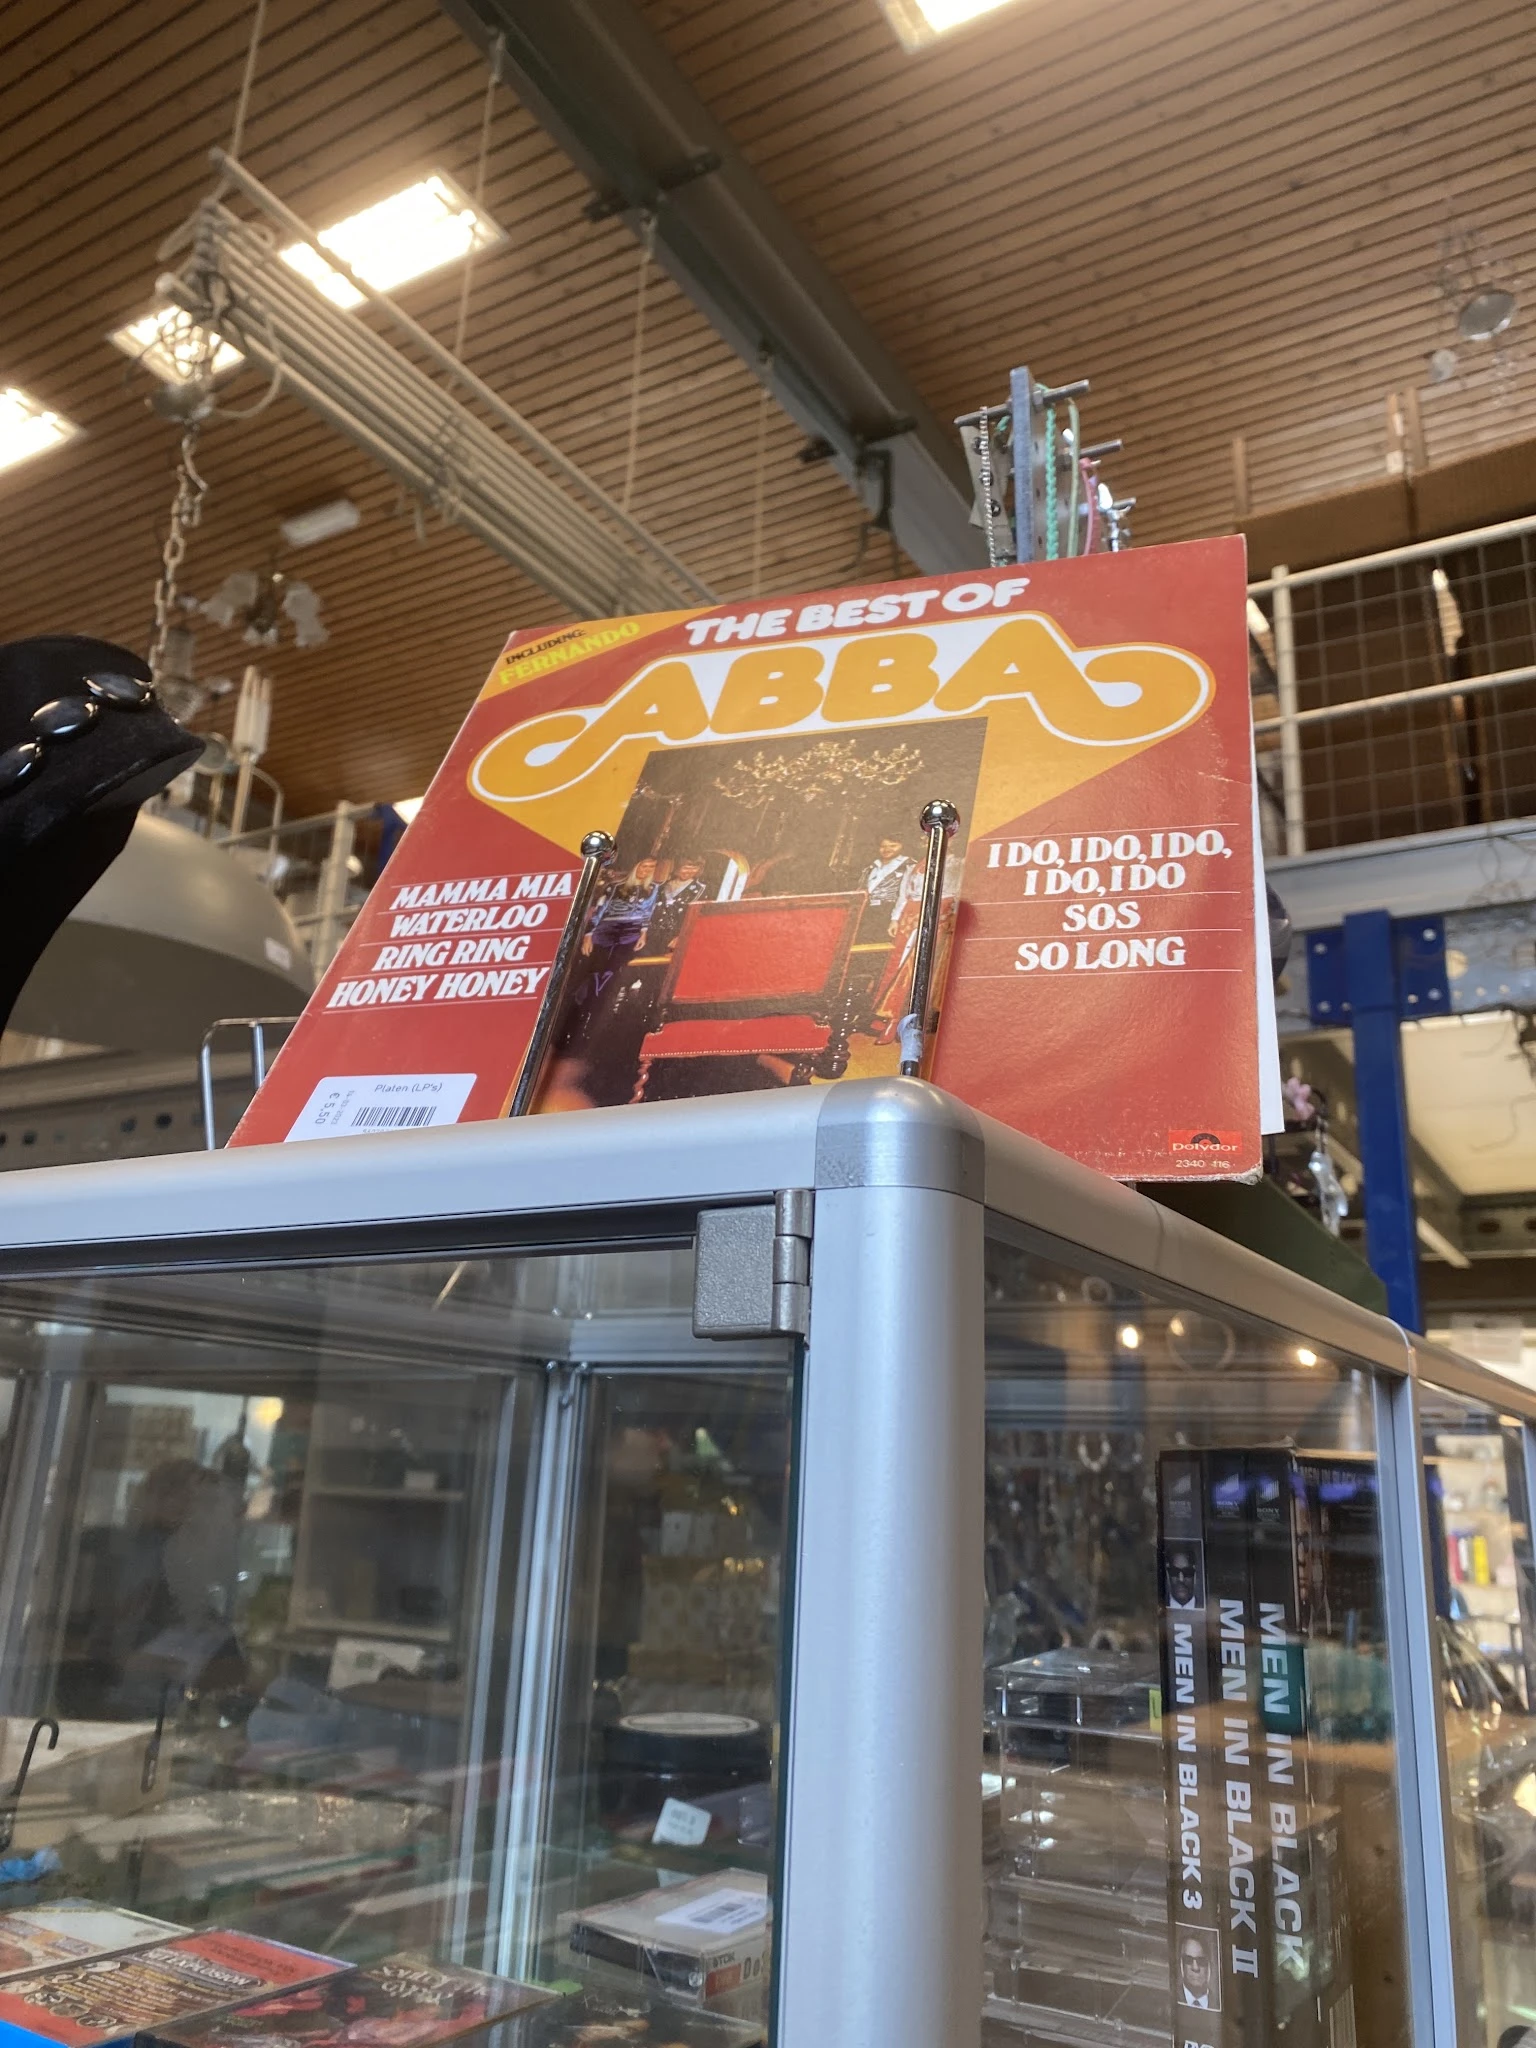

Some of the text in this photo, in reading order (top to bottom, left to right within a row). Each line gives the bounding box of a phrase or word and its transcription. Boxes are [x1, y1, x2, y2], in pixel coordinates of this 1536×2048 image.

[685, 577, 1030, 646] THE BEST OF
[499, 621, 641, 686] FERNANDO
[505, 627, 587, 665] INCLUDING:
[470, 612, 1213, 802] ABBA
[987, 829, 1232, 869] I DO, I DO, I DO,
[389, 873, 572, 911] MAMMA MIA
[1023, 862, 1186, 897] I DO, I DO
[390, 903, 549, 938] WATERLOO
[1062, 901, 1141, 932] SOS
[371, 935, 531, 972] RING RING
[1014, 936, 1186, 971] SO LONG
[326, 967, 550, 1008] HONEY HONEY
[329, 1092, 340, 1100] €
[374, 1082, 443, 1093] Platen (LP's)
[1175, 1159, 1230, 1169] 2340 116
[1173, 1623, 1203, 1910] MEN IN BLACK 3
[1219, 1599, 1259, 1978] MEN IN BLACK II
[1259, 1602, 1305, 1973] MEN IN BLACK
